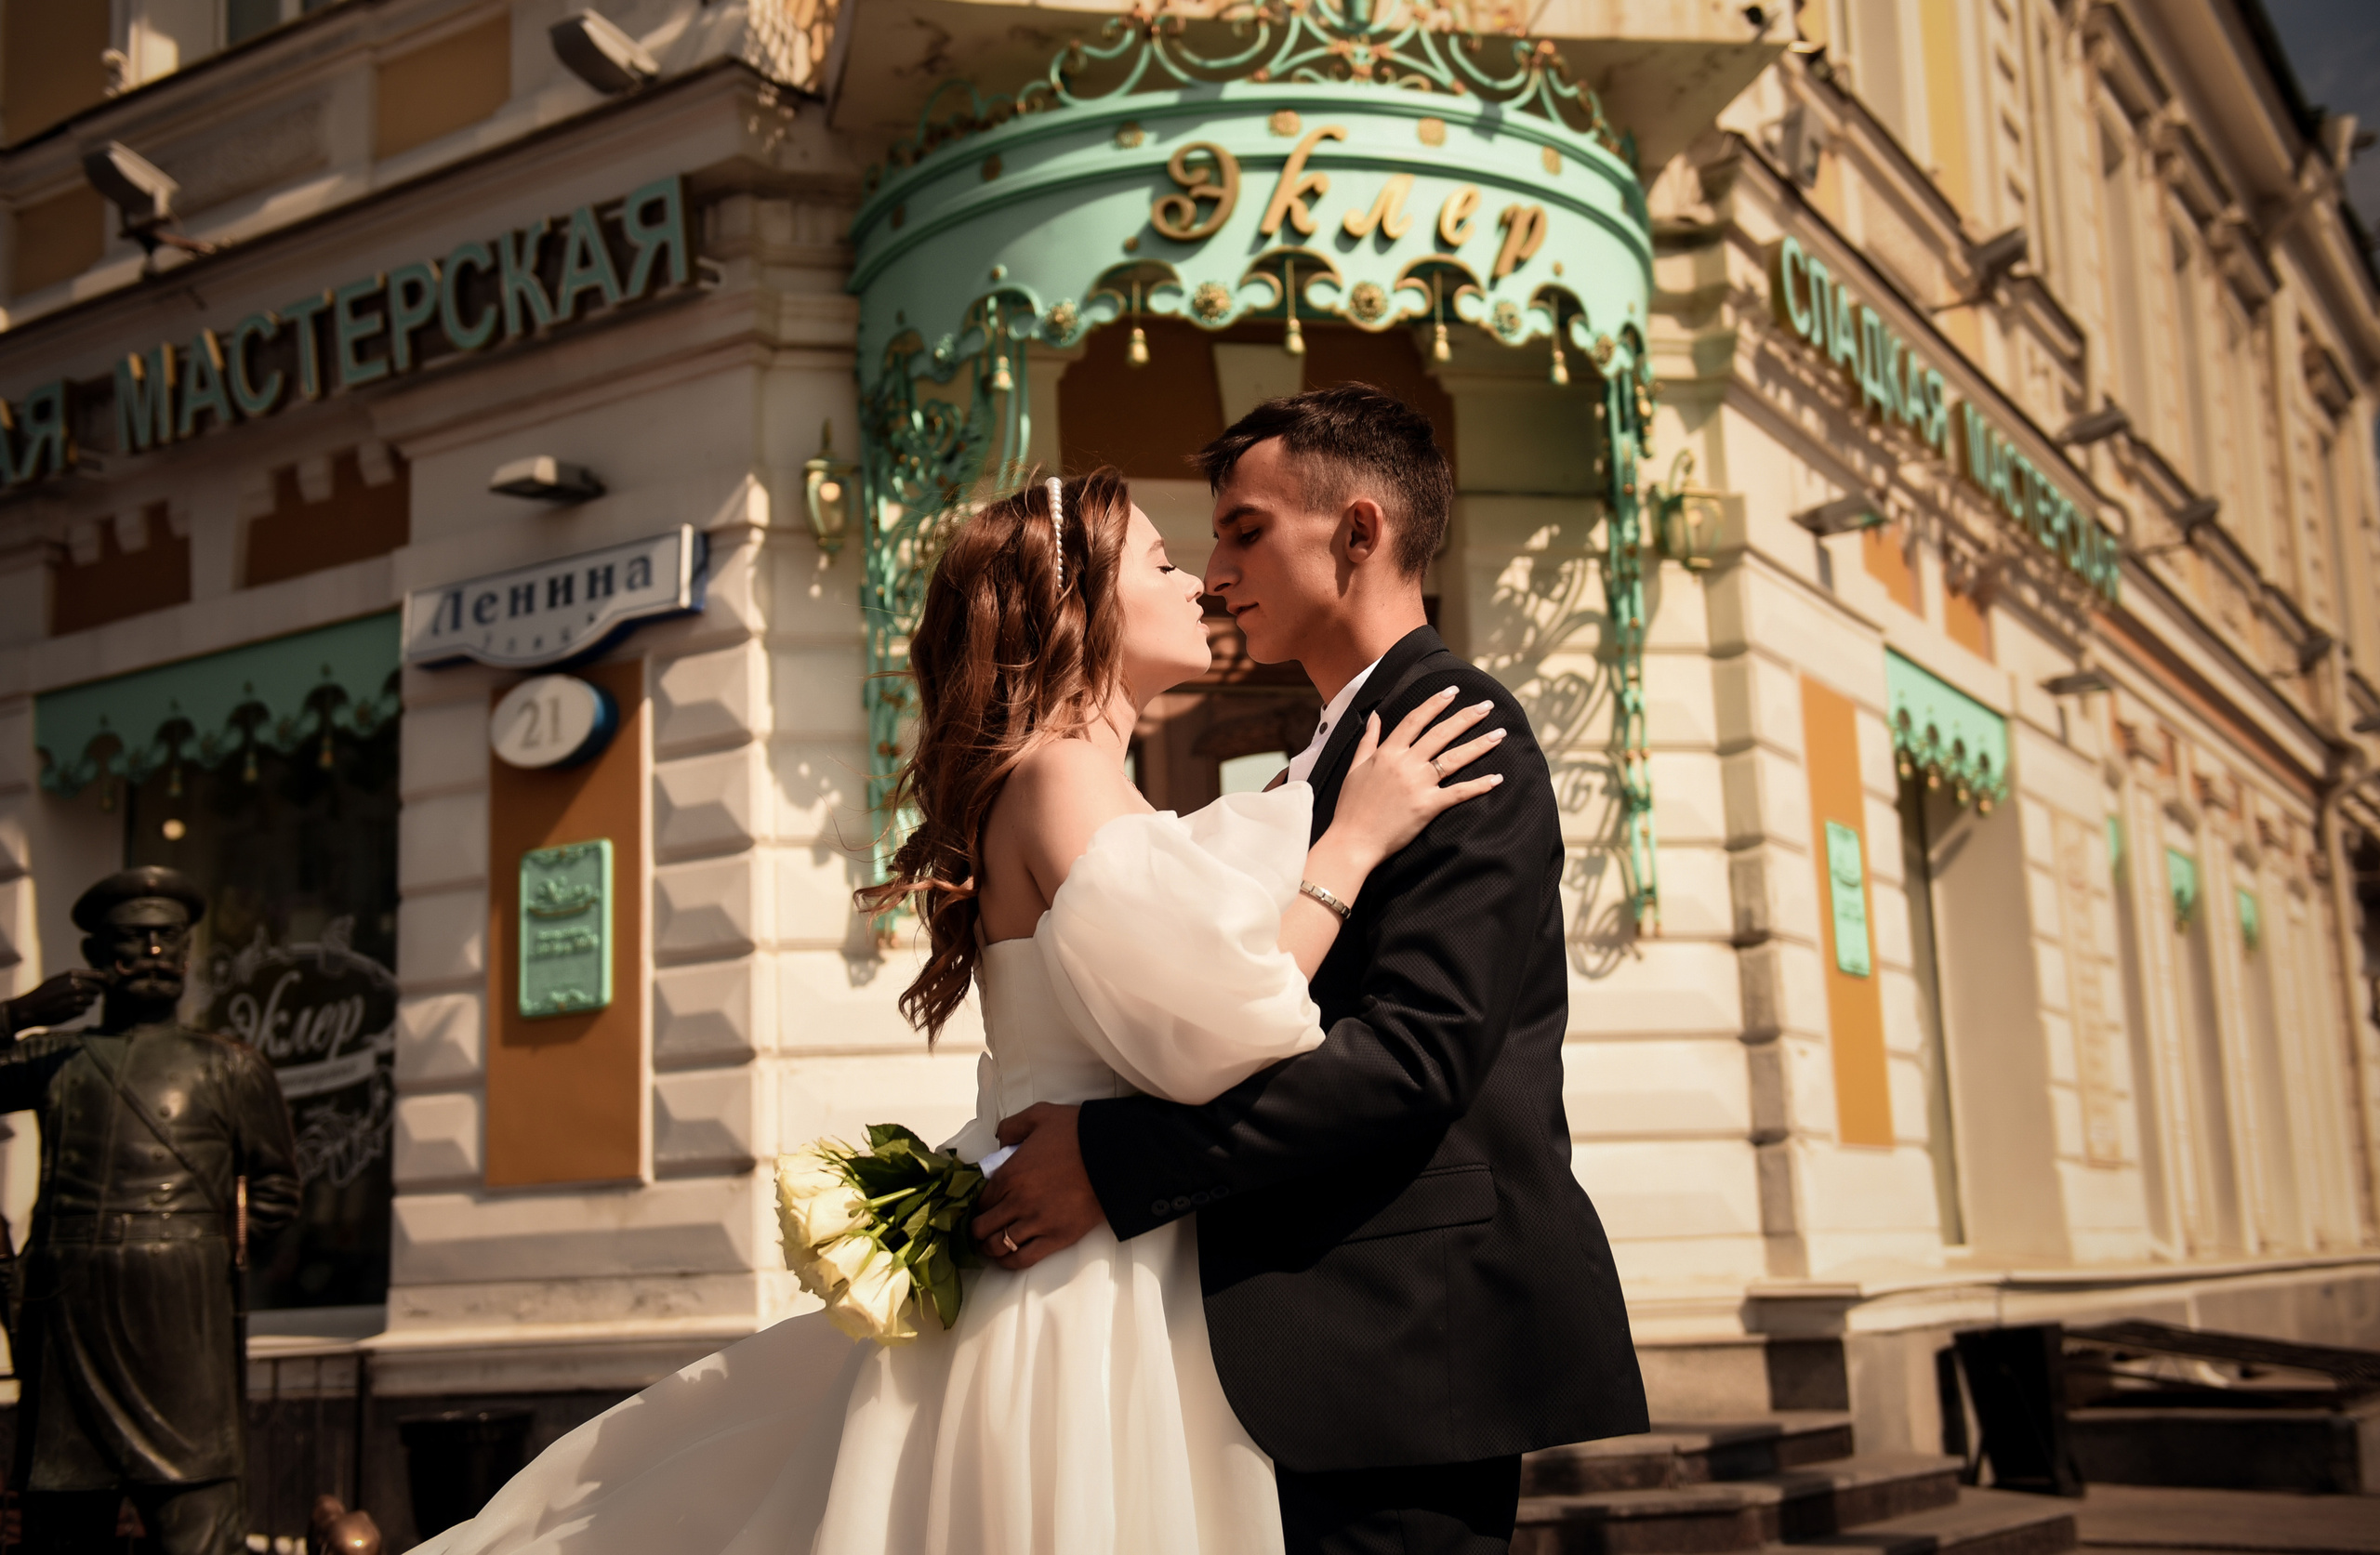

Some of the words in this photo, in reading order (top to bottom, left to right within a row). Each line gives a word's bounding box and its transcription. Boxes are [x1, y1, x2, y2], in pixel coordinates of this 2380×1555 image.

[1151, 125, 1548, 277] Эклер
[115, 174, 690, 453] МАСТЕРСКАЯ
[1781, 235, 1950, 458] СЛАДКАЯ
[431, 556, 654, 637] Ленина
[518, 694, 565, 749] 21
